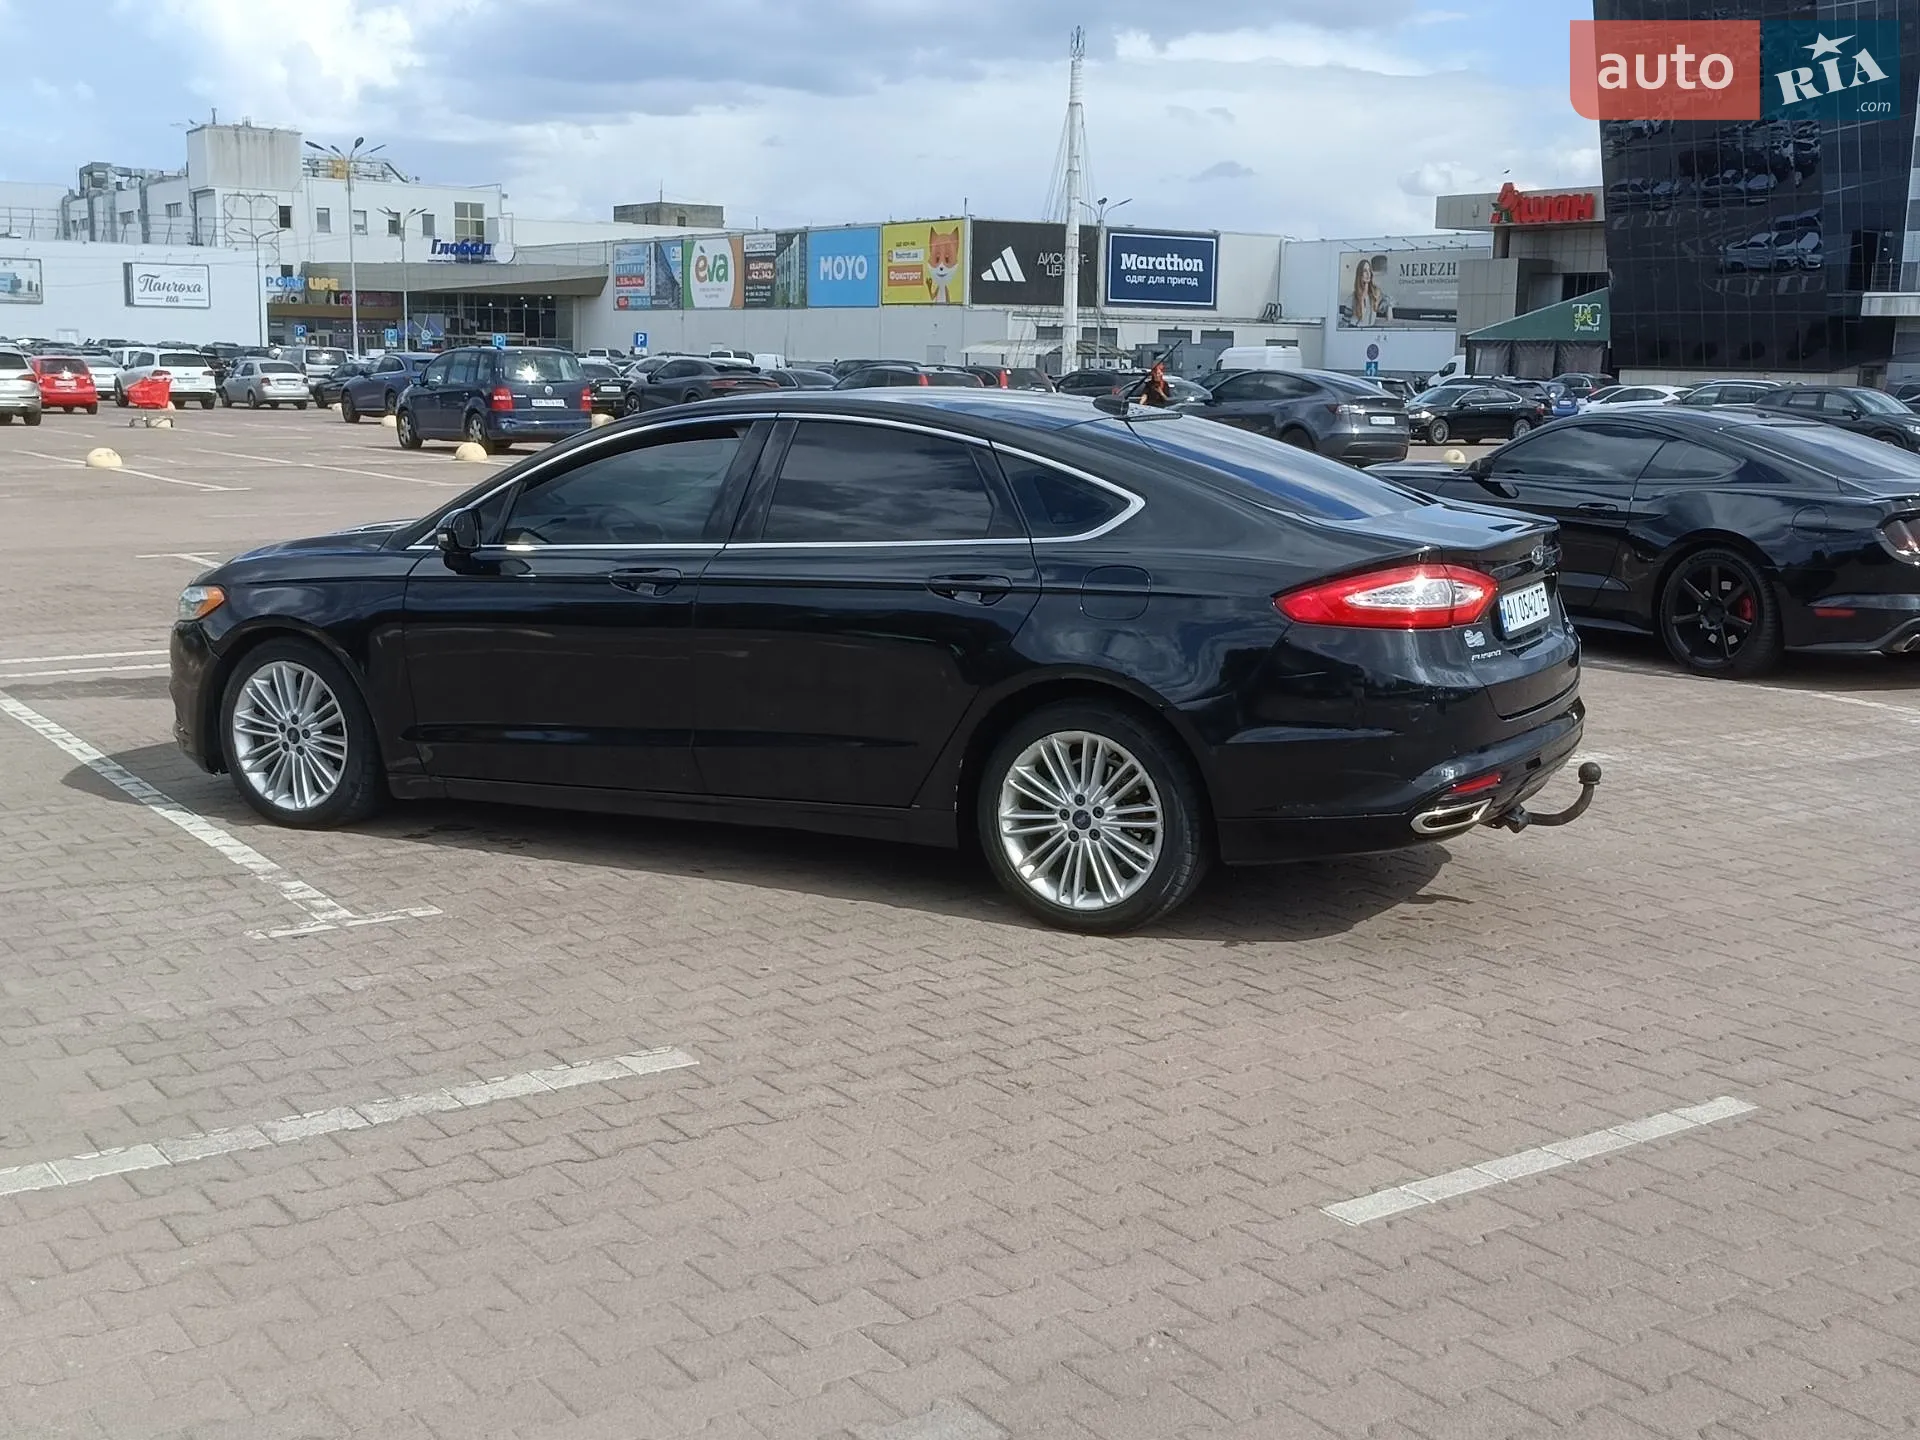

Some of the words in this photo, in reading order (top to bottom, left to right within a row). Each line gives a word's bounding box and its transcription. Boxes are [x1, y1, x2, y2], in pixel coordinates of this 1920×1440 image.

[430, 239, 492, 255] Глобал
[820, 255, 868, 281] MOYO
[1120, 253, 1204, 272] Marathon
[138, 273, 203, 293] Панчоха
[889, 270, 922, 281] Фокстрот
[1125, 275, 1147, 284] одяг
[1147, 275, 1165, 285] для
[1166, 276, 1199, 287] пригод
[637, 333, 645, 346] P
